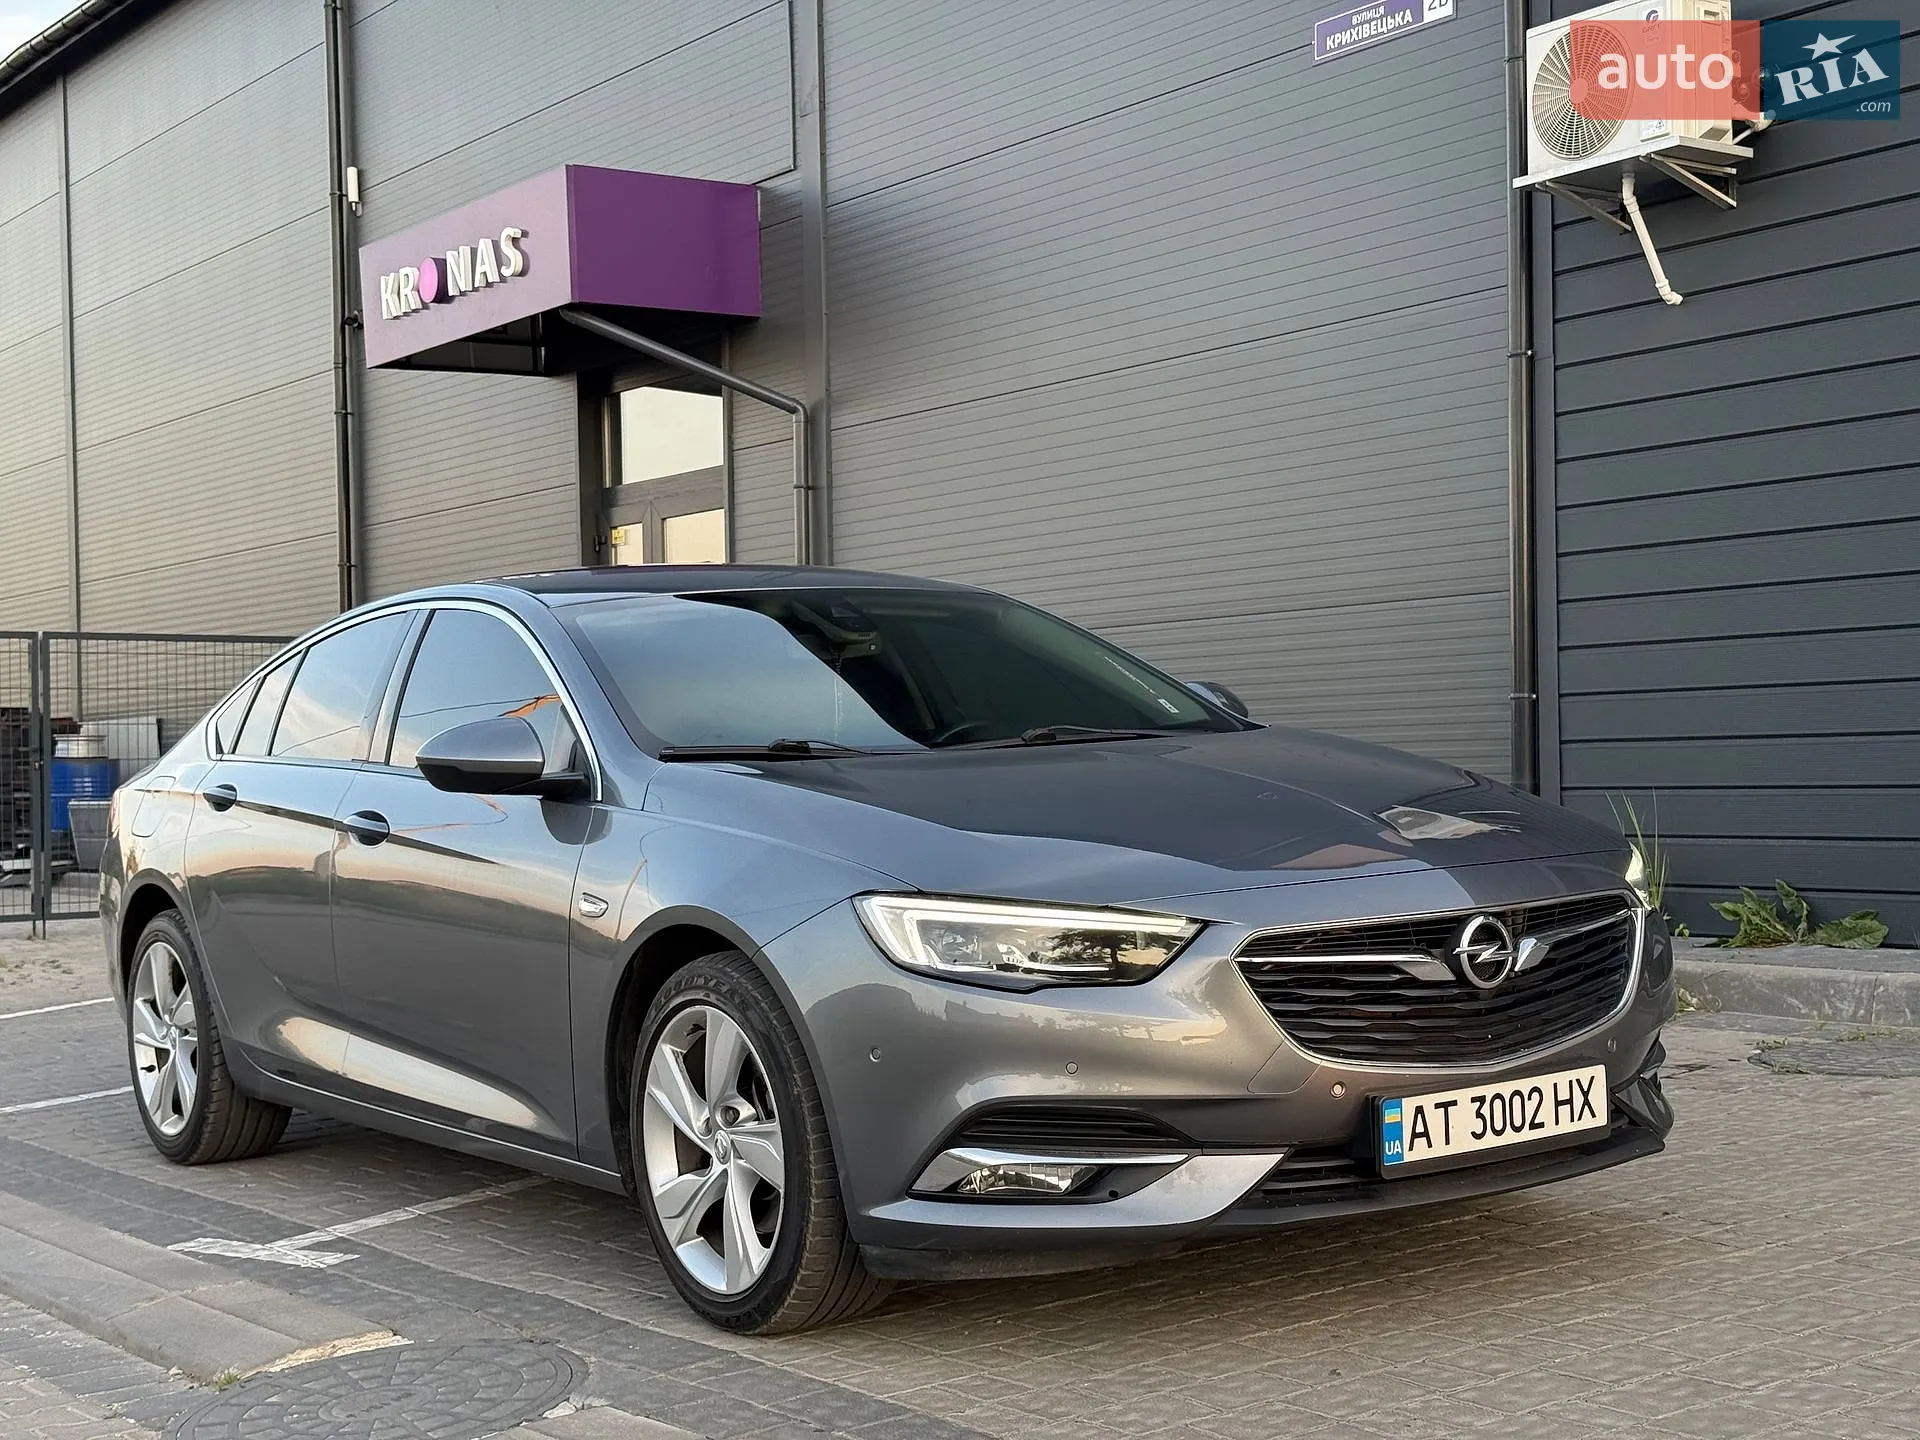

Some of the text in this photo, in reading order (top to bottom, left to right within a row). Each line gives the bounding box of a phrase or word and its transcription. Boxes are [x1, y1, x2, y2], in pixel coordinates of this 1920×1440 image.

[1326, 9, 1413, 50] КРИХІВЕЦЬКА
[1352, 5, 1385, 25] ВУЛИЦЯ
[380, 226, 524, 320] KRONAS
[1408, 1075, 1597, 1152] AT 3002 HX
[1385, 1141, 1402, 1156] UA
